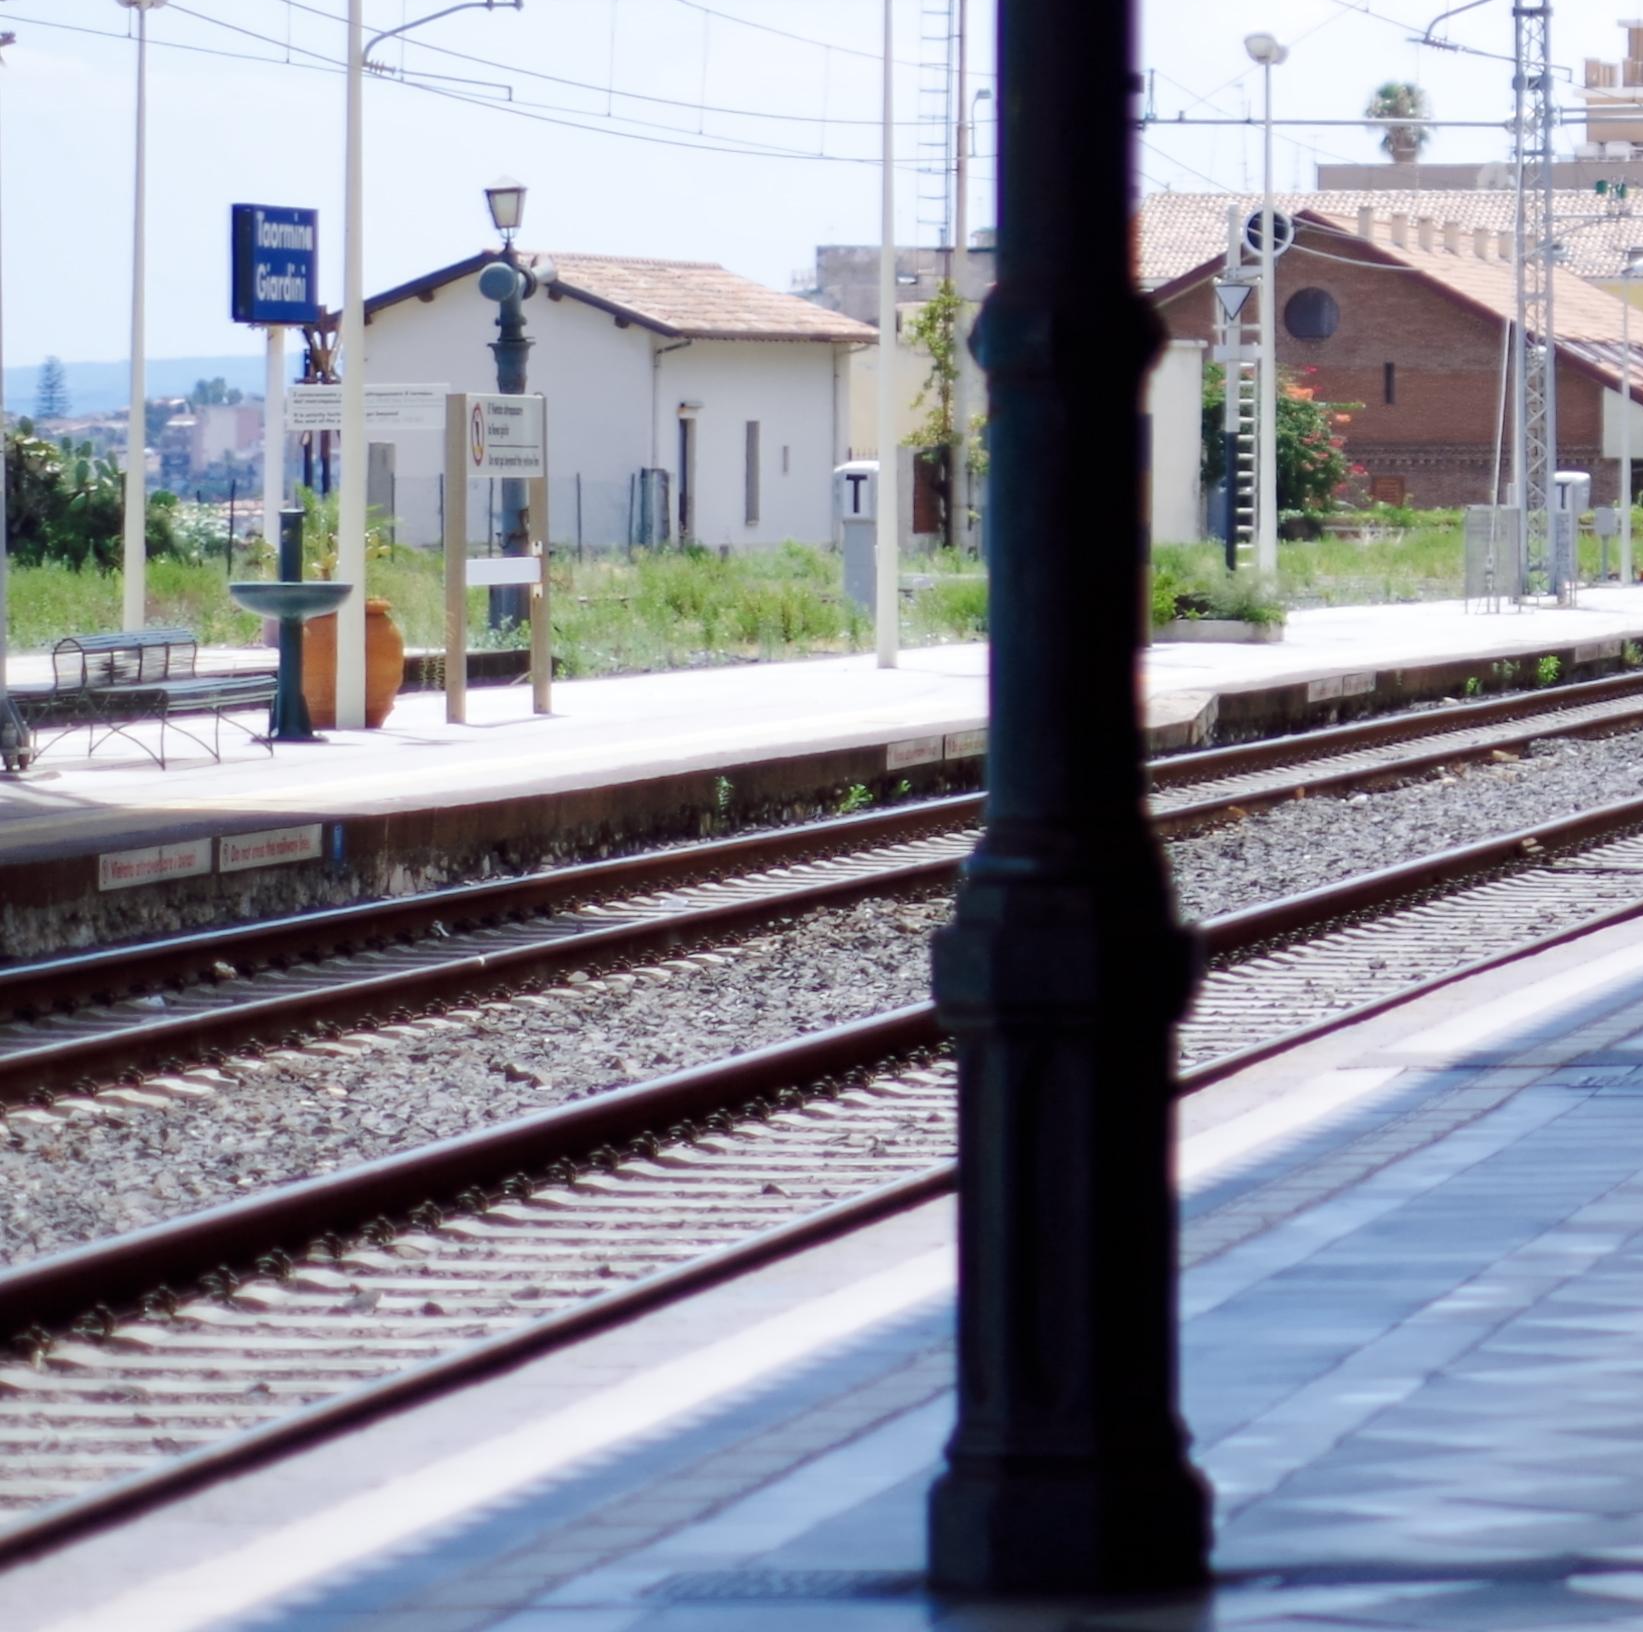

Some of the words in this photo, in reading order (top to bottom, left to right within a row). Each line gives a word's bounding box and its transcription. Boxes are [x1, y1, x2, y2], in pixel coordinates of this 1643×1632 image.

[256, 211, 313, 251] Taormina
[256, 263, 306, 301] Giardini
[847, 474, 867, 514] T
[1556, 481, 1571, 509] T
